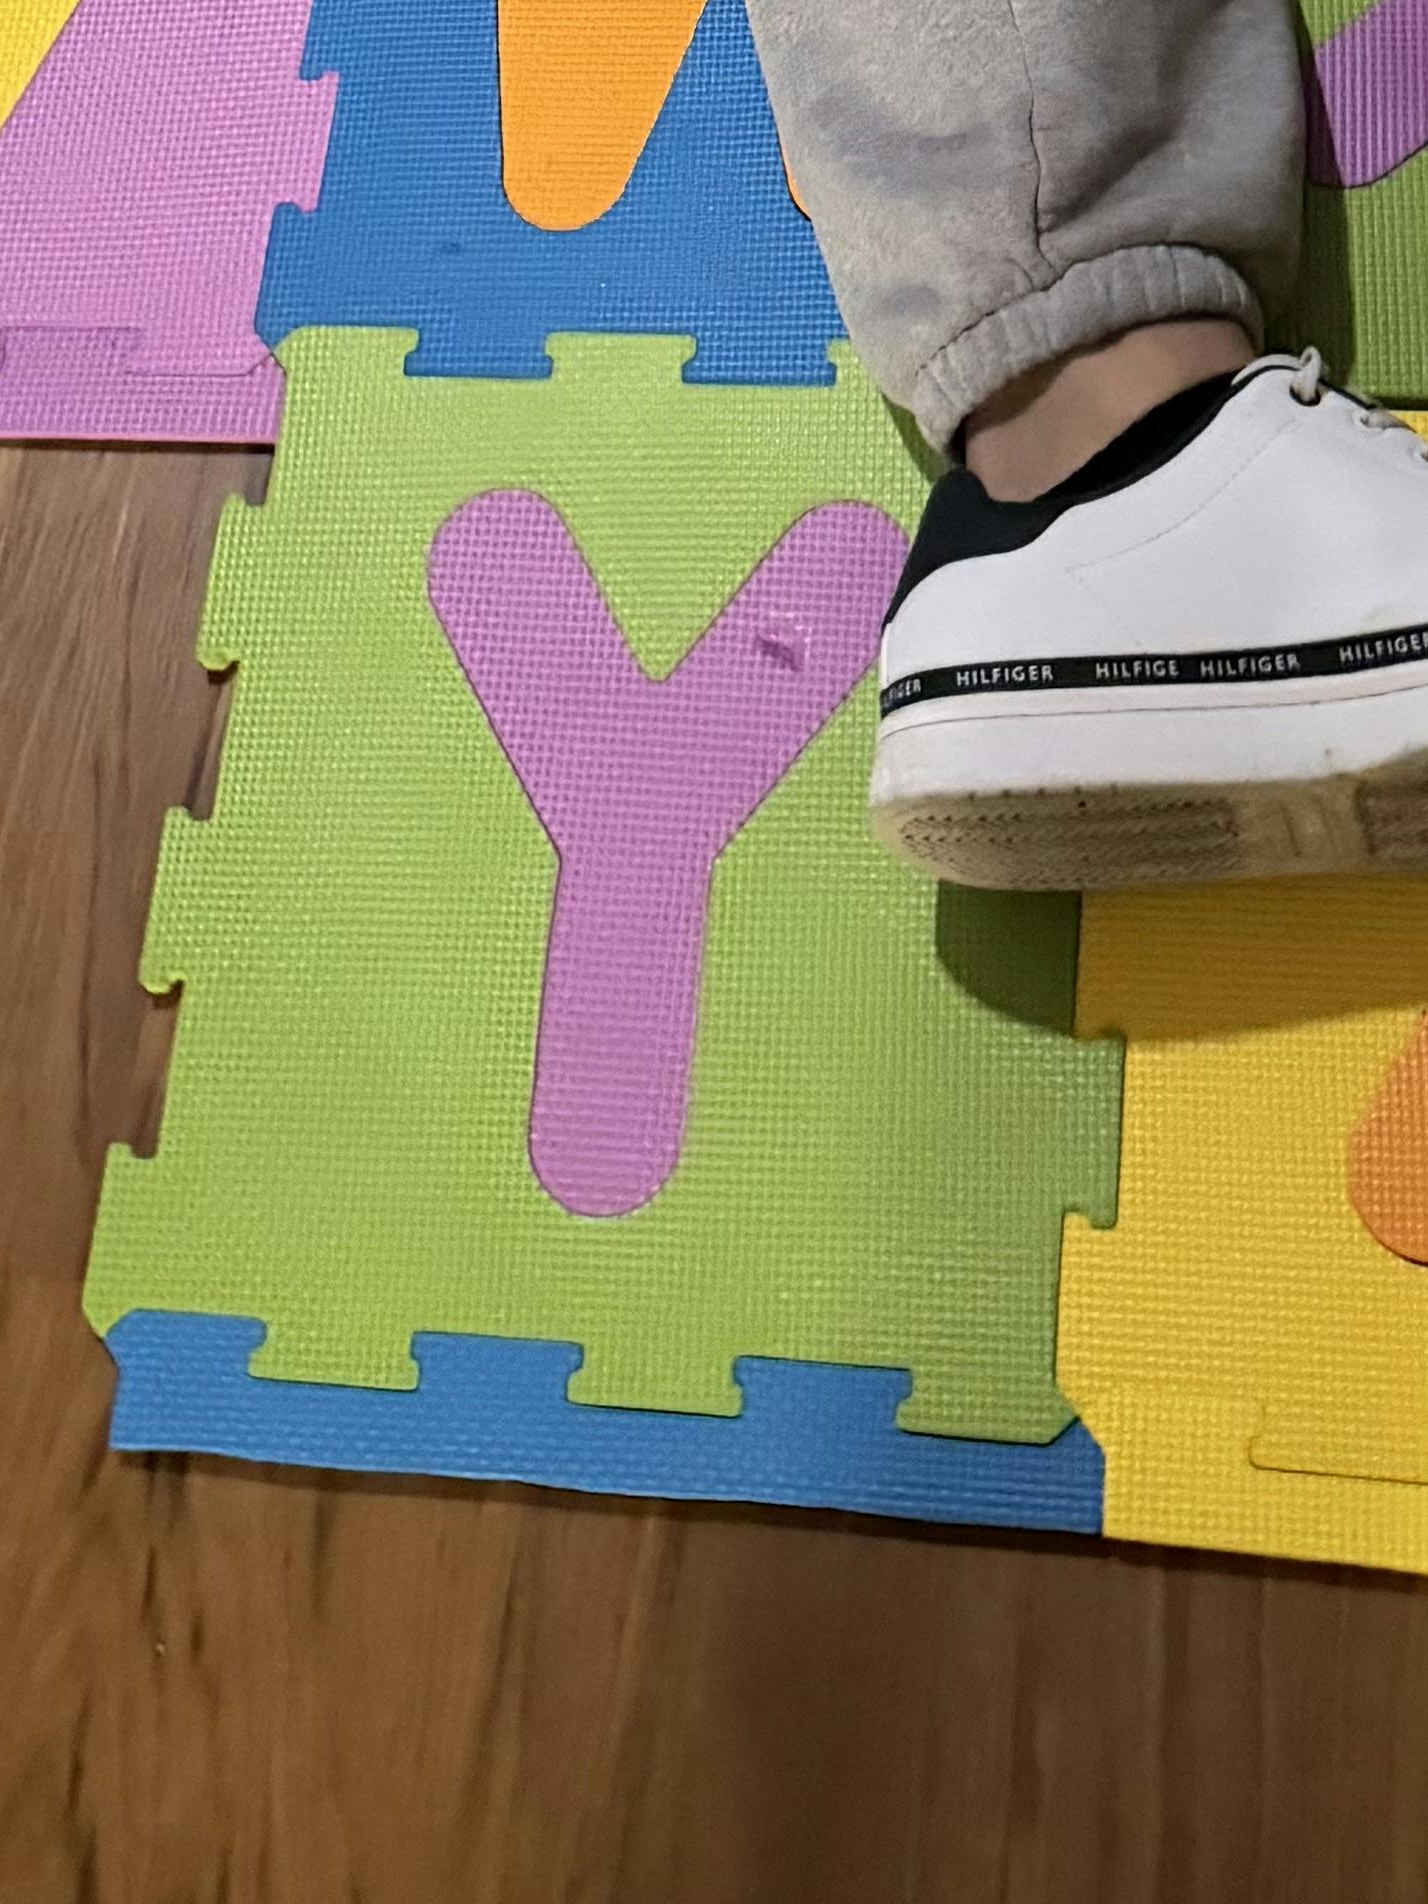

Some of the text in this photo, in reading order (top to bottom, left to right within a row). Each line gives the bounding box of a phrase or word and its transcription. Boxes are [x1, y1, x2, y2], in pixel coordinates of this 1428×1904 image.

[426, 488, 910, 1219] Y
[955, 665, 1054, 687] HILFIGER
[1199, 653, 1301, 678] HILFIGER
